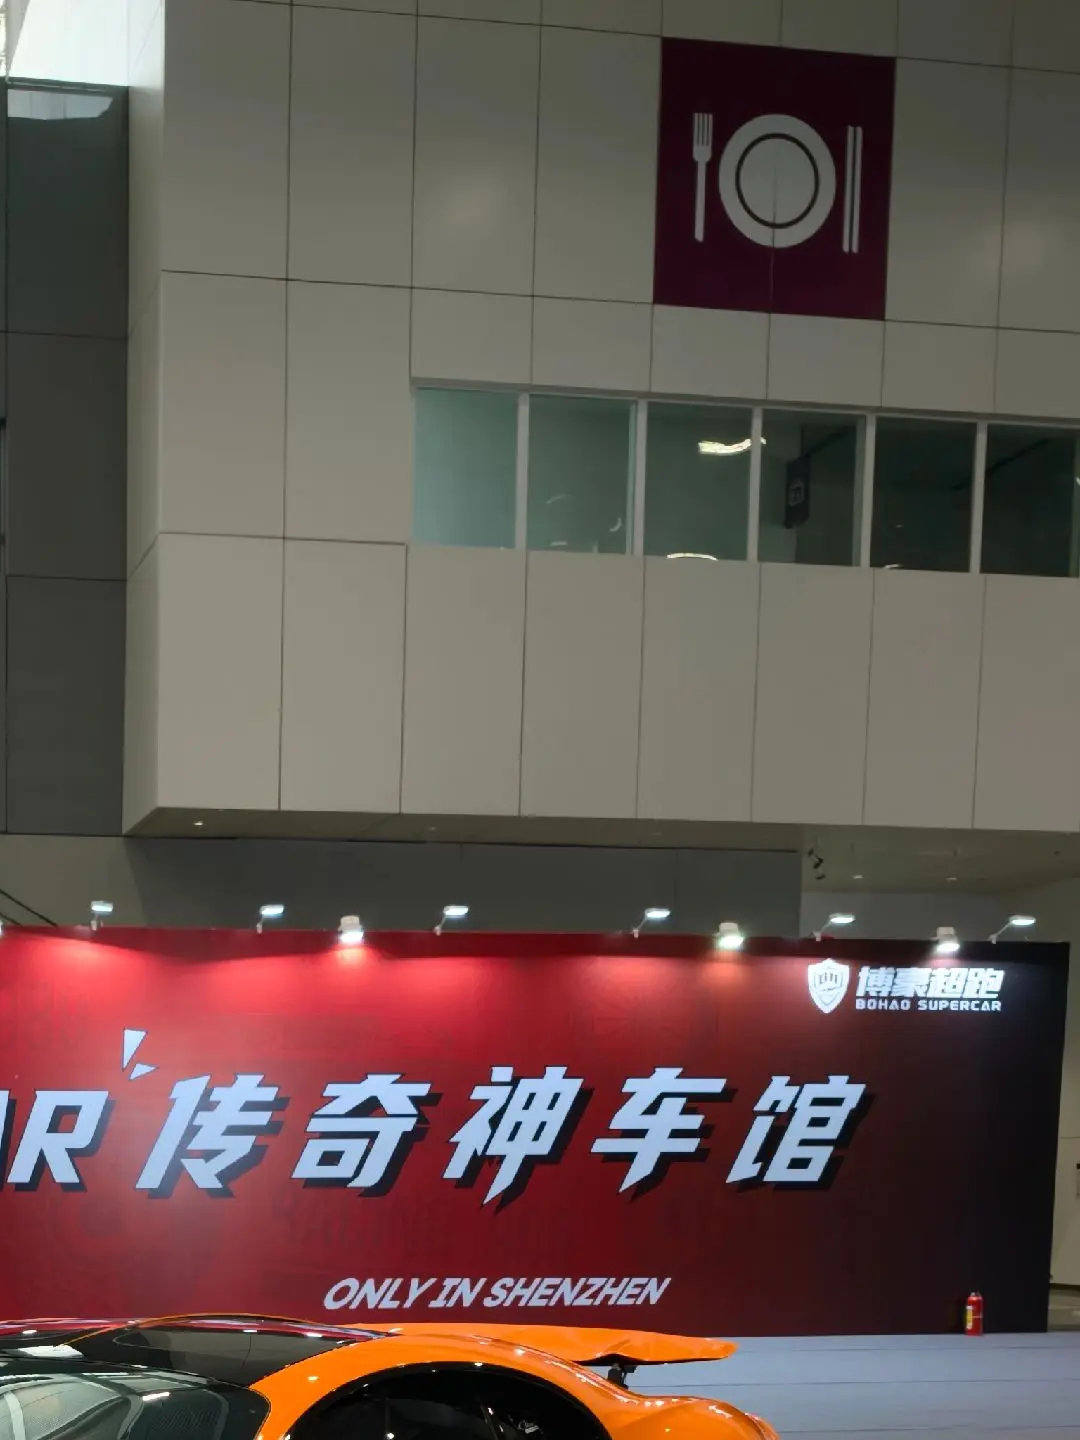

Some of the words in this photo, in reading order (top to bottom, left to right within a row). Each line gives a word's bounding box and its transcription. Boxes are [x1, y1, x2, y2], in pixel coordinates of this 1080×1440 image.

[855, 998, 911, 1011] BOHAO
[917, 999, 1002, 1012] SUPERCAR
[135, 1064, 867, 1206] 传奇神车馆
[323, 1277, 437, 1310] ONLY
[428, 1277, 487, 1309] IN
[483, 1277, 672, 1308] SHENZHEN
